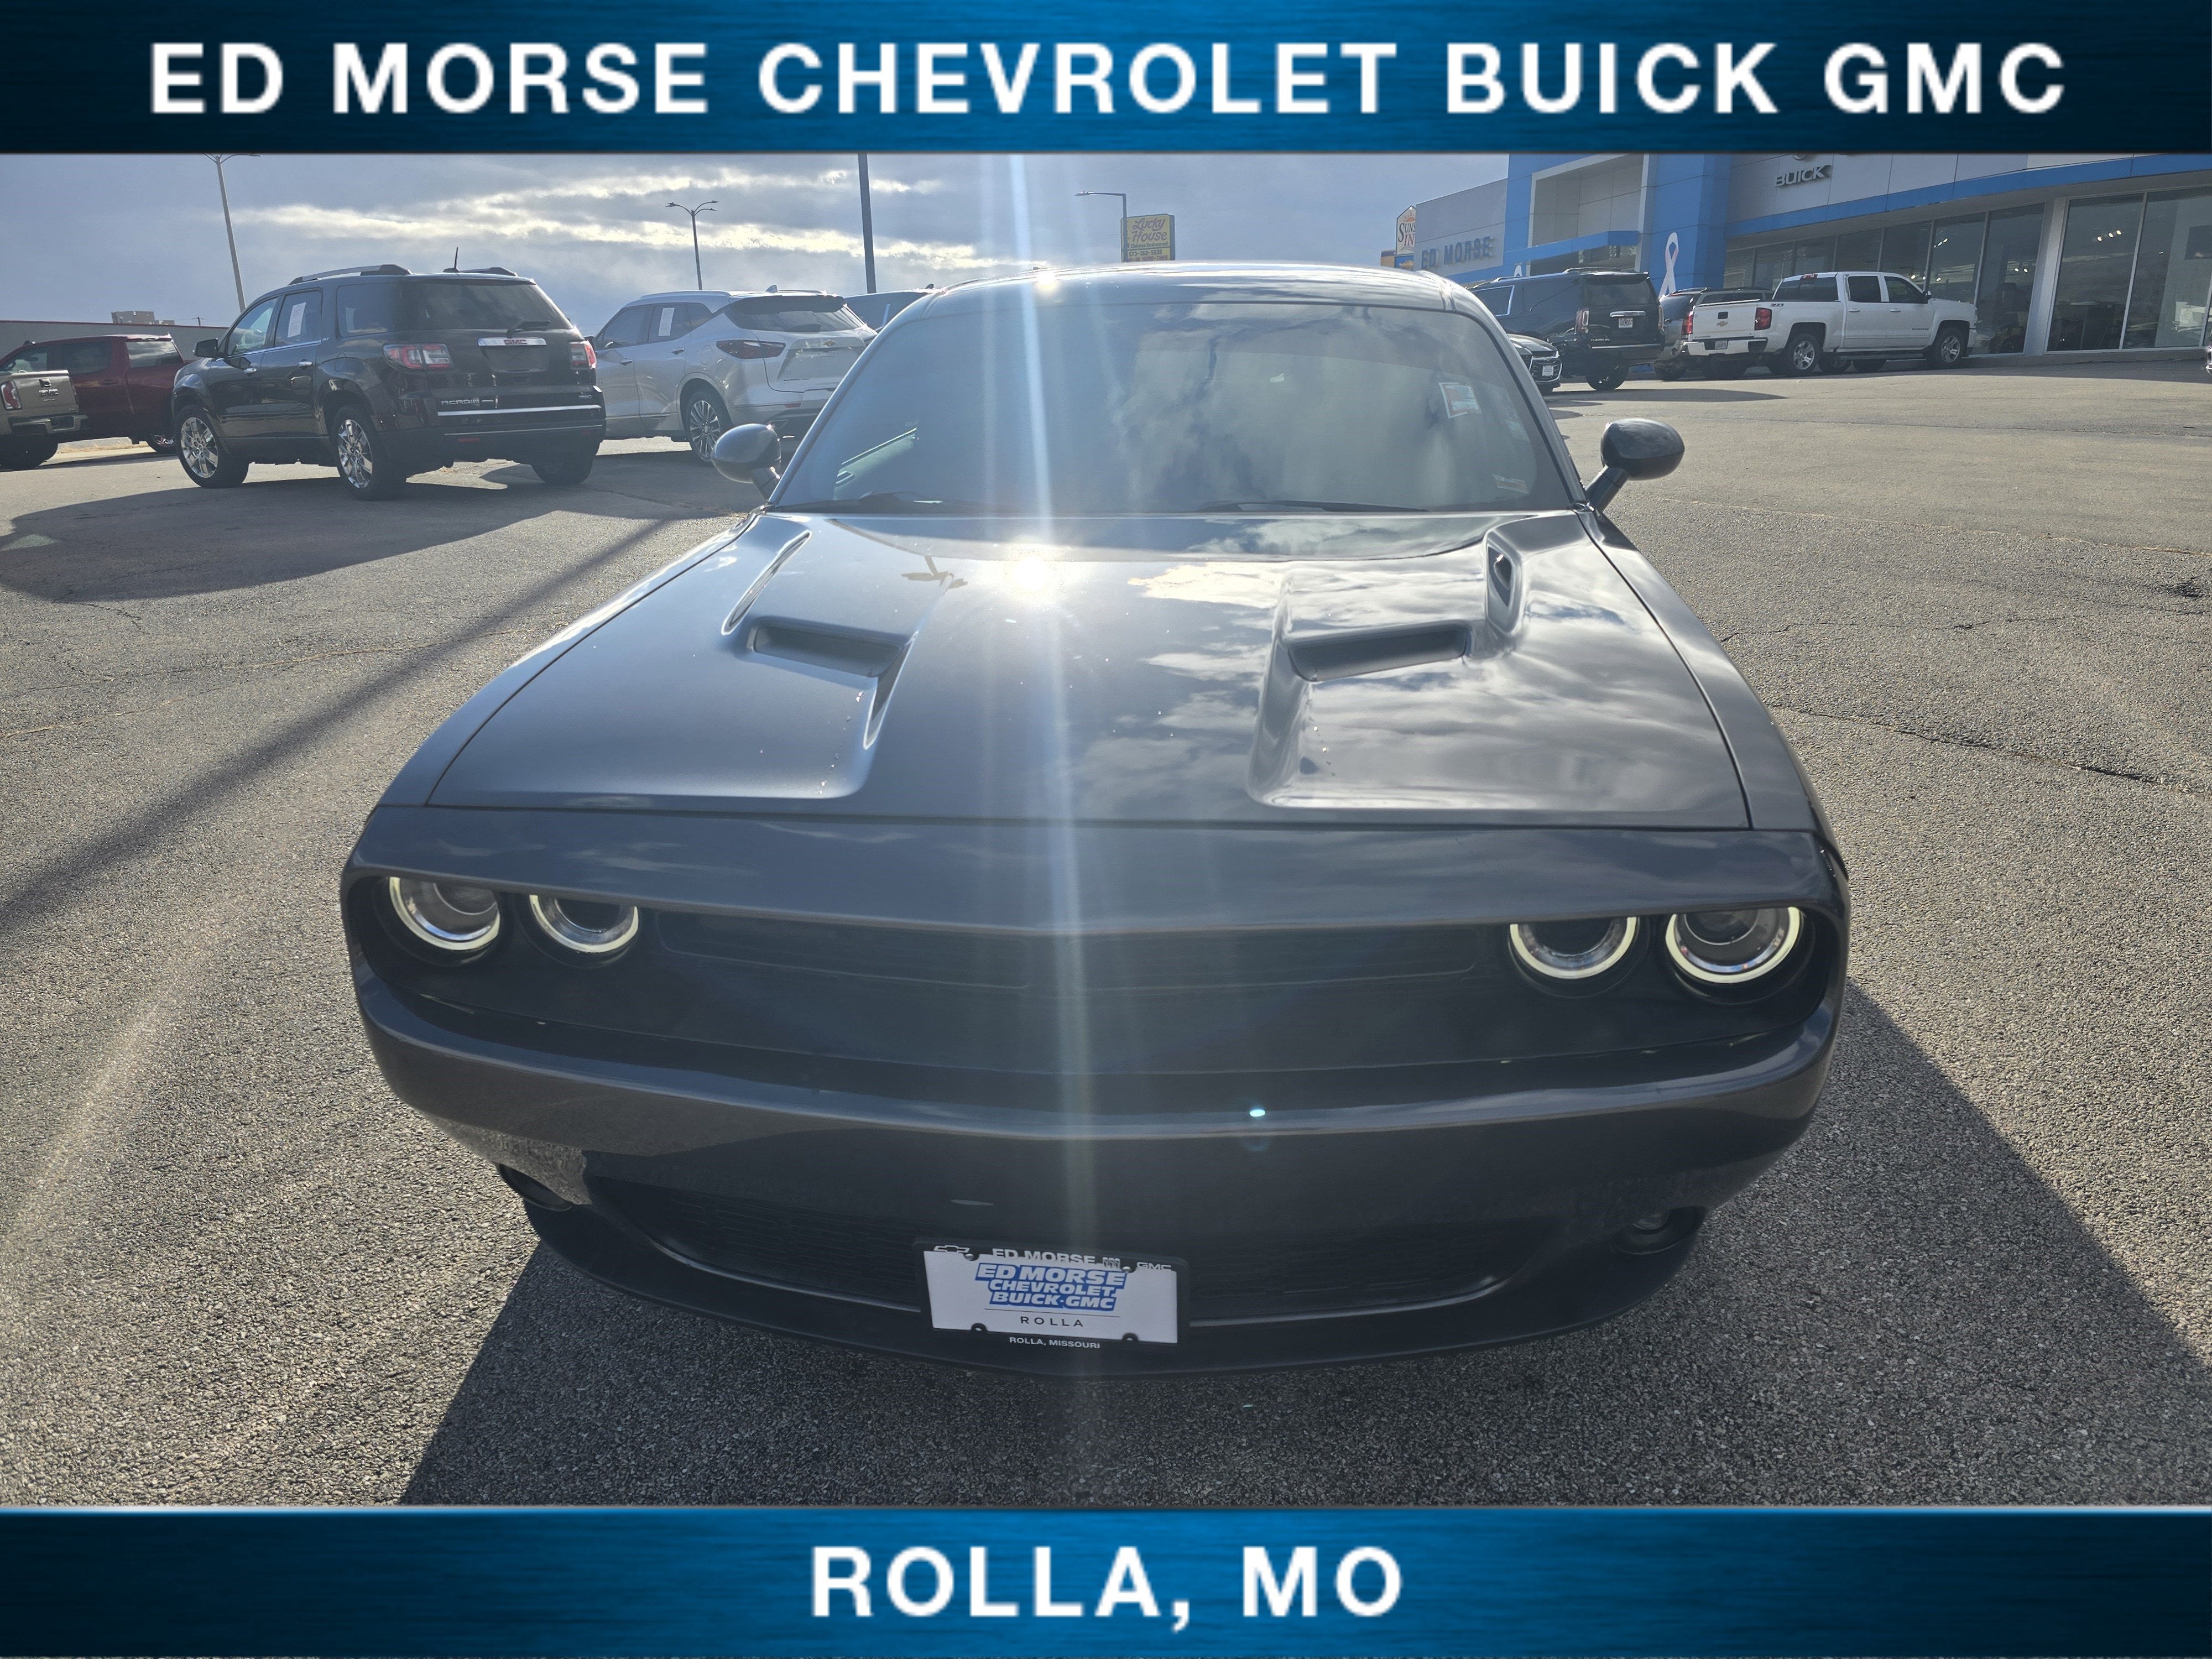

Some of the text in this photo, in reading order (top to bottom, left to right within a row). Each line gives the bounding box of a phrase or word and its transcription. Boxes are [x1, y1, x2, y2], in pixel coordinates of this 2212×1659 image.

[1775, 165, 1829, 187] BUICK
[1133, 217, 1166, 231] Lucky
[1131, 231, 1167, 243] House
[1421, 236, 1491, 269] ED MORSE
[992, 1248, 1095, 1264] ED MORSE
[1136, 1261, 1172, 1271] GMC
[977, 1264, 1126, 1286] ED MORSE
[989, 1279, 1115, 1297] CHEVROLET
[1020, 1316, 1083, 1327] ROLLA
[1009, 1337, 1100, 1349] ROLLA, MISSOURI
